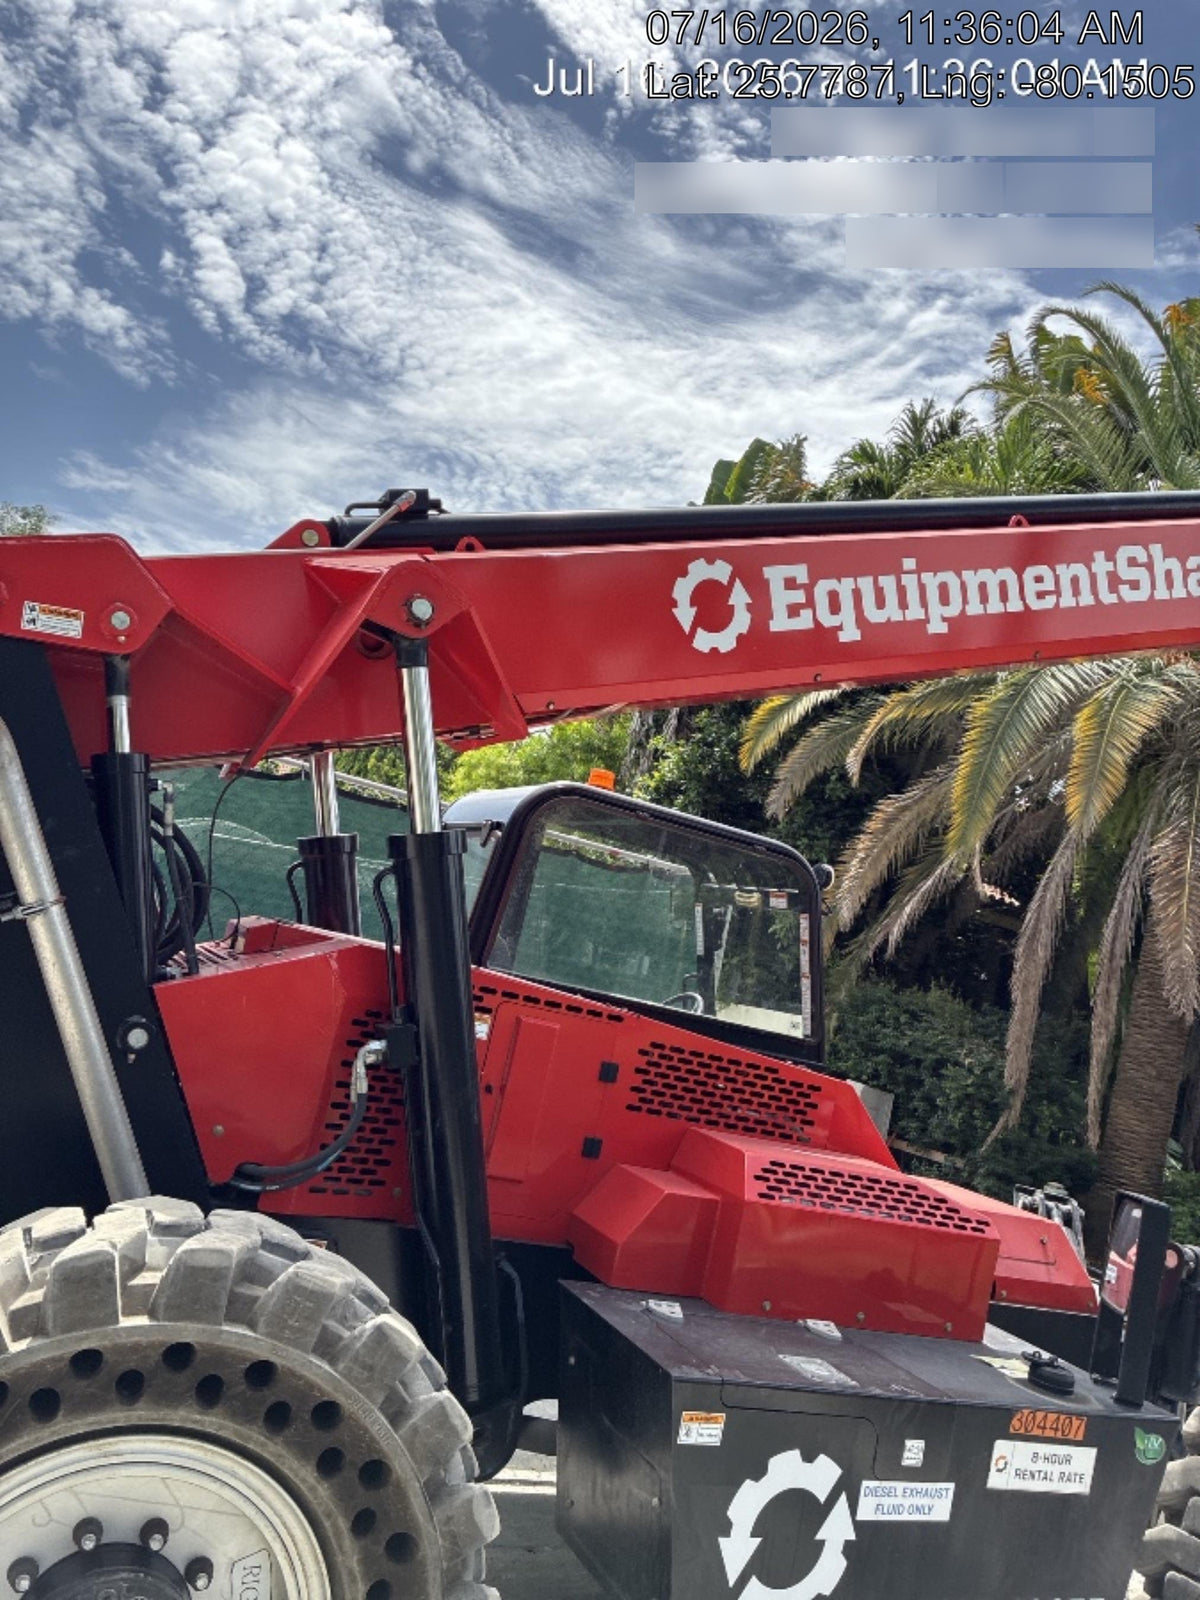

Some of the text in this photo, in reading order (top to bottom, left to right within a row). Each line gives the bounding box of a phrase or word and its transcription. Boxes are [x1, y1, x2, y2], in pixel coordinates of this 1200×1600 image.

[1011, 1410, 1086, 1439] 304407
[1031, 1452, 1073, 1465] 8-HOUR
[1013, 1468, 1086, 1484] RENTAL RATE
[863, 1485, 951, 1500] DIESEL EXHAUST
[874, 1503, 934, 1516] FLUID ONLY
